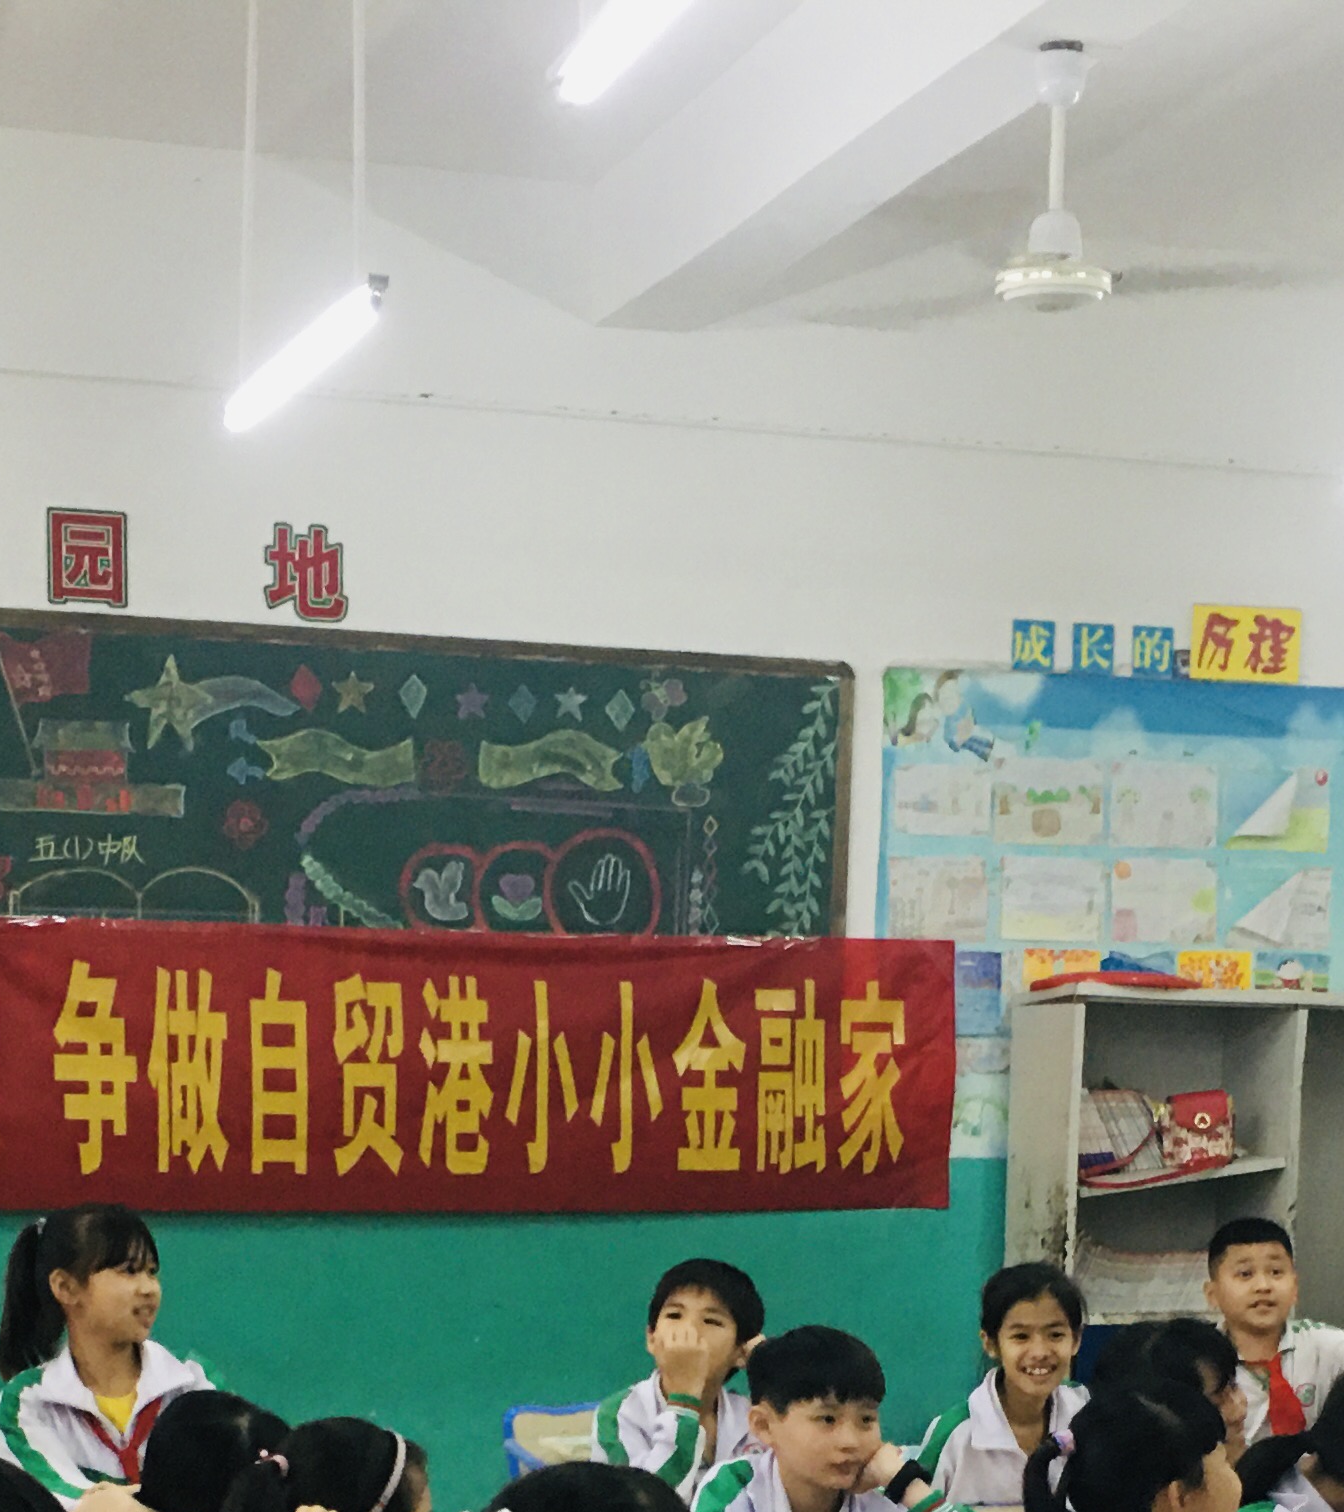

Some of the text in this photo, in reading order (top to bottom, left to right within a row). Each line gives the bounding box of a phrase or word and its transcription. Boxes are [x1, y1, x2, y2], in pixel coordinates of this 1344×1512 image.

[51, 958, 909, 1178] 争做自贸港小小金融家
